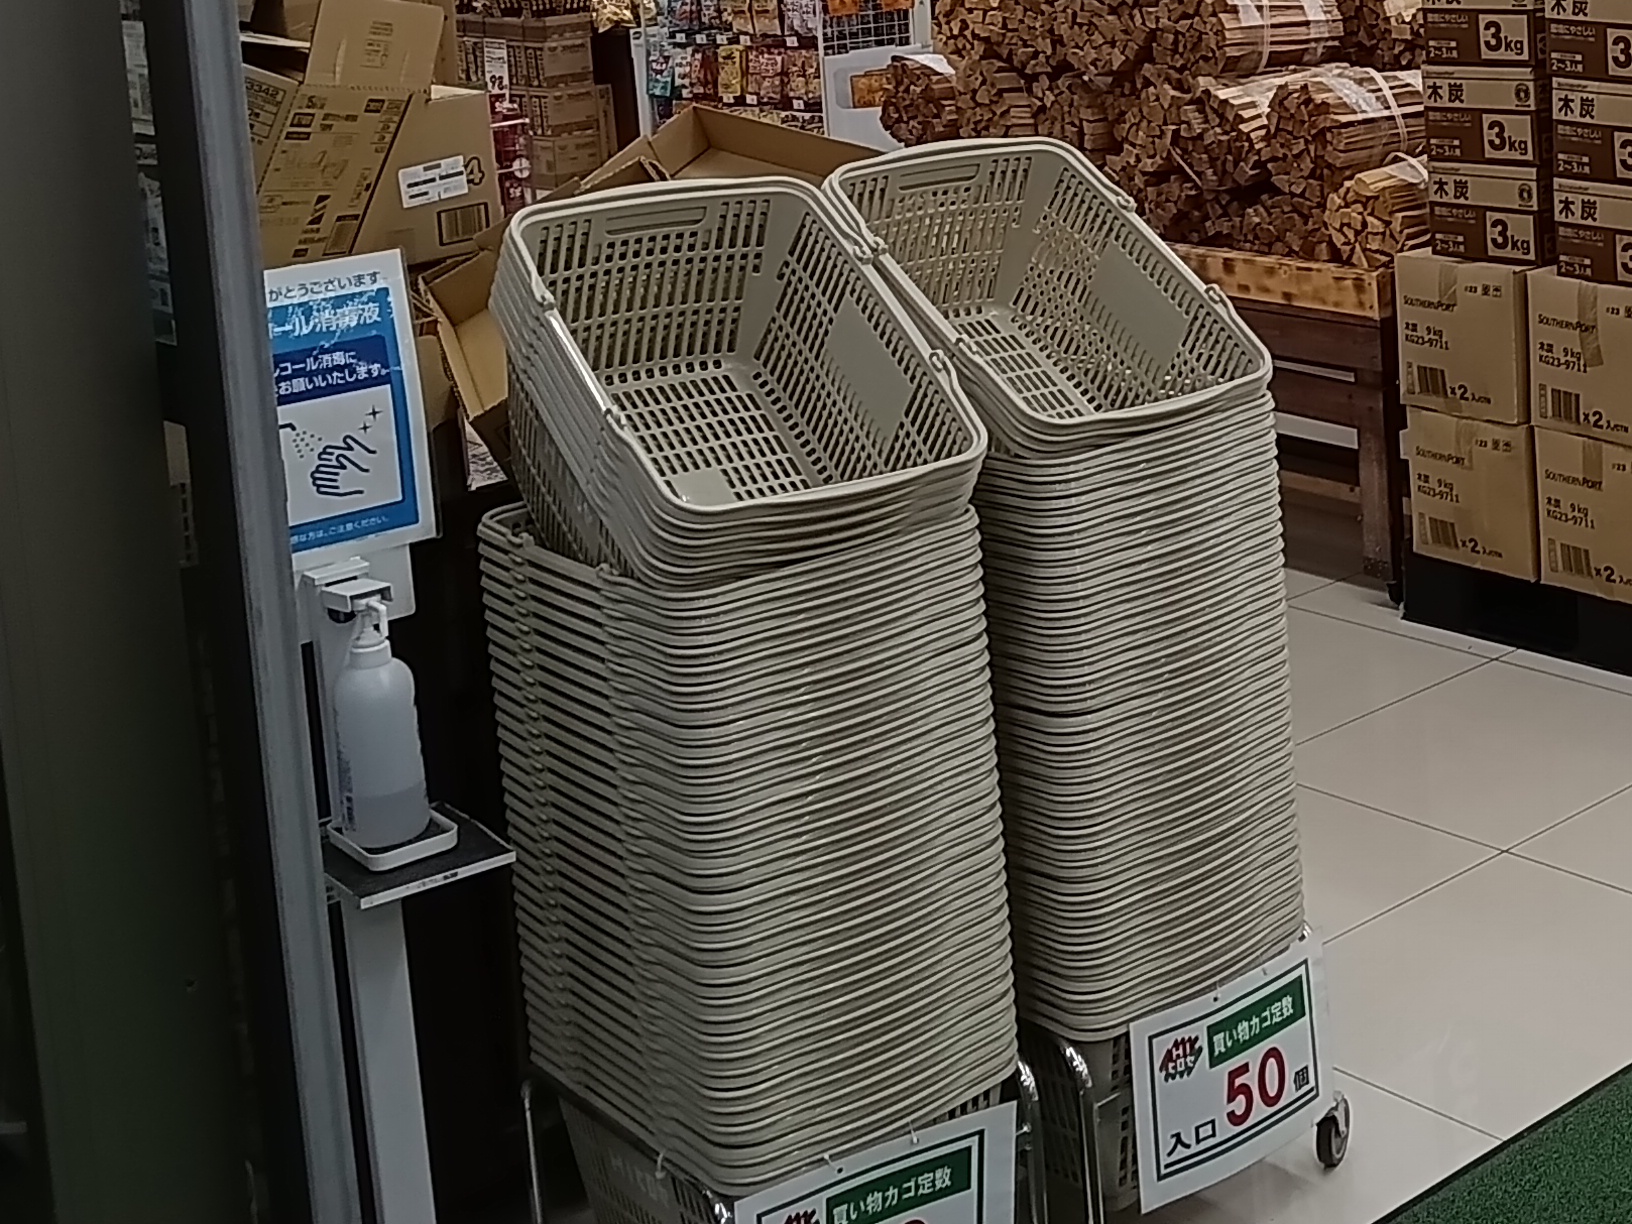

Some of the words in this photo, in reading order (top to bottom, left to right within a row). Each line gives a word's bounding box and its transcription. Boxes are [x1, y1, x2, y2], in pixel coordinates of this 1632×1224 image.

[1427, 82, 1465, 104] 木炭
[1558, 94, 1596, 119] 木炭
[1433, 177, 1470, 201] 木炭
[1559, 197, 1598, 222] 木炭
[268, 302, 381, 339] ール消毒液
[1213, 995, 1294, 1058] 買い物カゴ定数
[1226, 1046, 1286, 1127] 50
[1293, 1065, 1309, 1093] 個
[1166, 1118, 1217, 1157] 入口
[833, 1165, 952, 1224] 買い物カゴ定数
